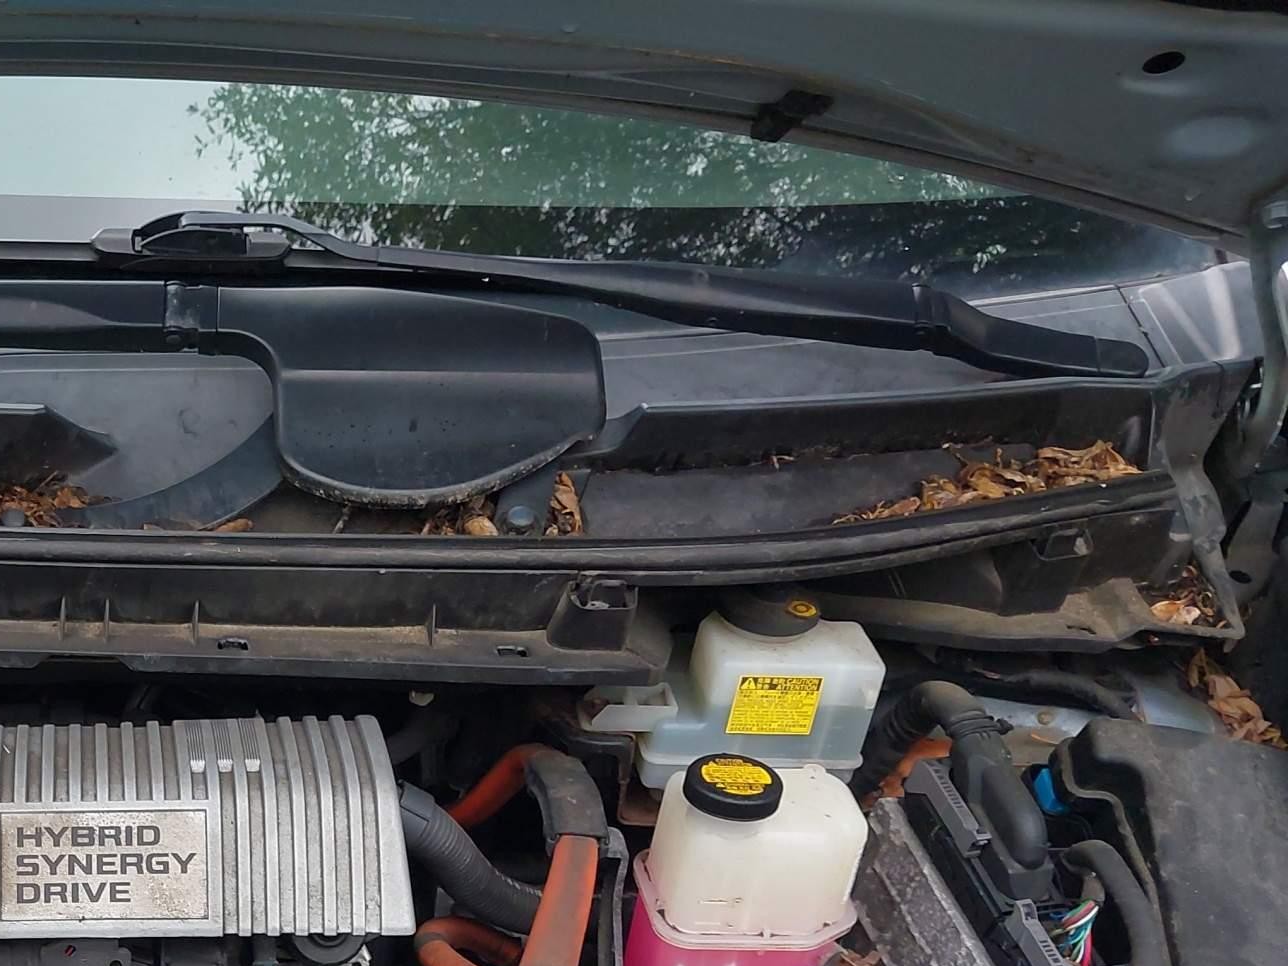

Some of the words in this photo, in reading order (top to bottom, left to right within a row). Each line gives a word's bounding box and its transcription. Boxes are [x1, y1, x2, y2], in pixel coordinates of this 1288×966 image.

[16, 826, 161, 848] HYBRID
[16, 853, 197, 876] SYNERGY
[16, 881, 131, 904] DRIVE
